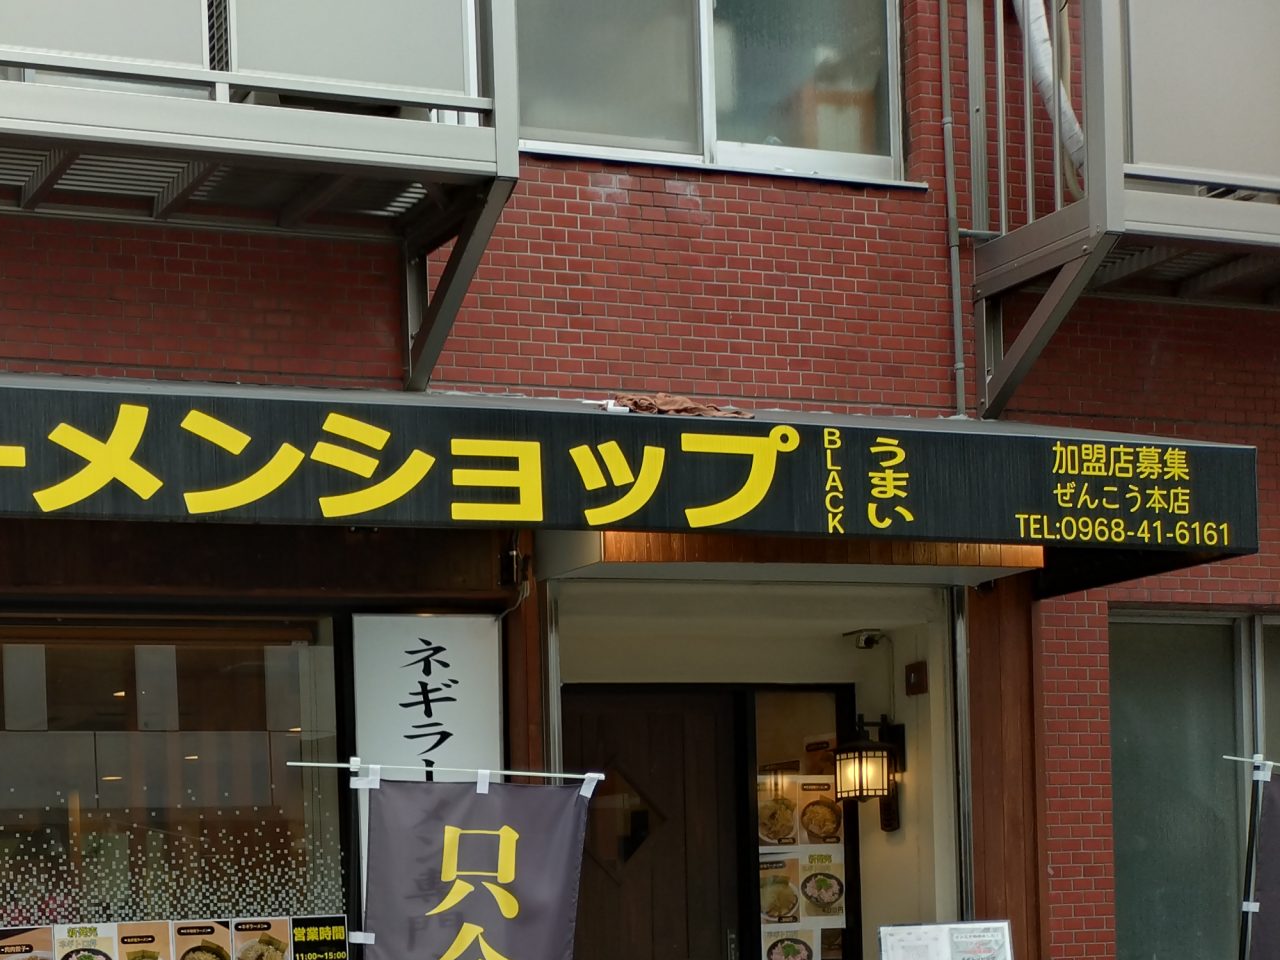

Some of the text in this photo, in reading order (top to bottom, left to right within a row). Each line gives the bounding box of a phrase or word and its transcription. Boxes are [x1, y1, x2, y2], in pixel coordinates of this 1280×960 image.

[1051, 440, 1191, 482] 加盟店募集
[823, 427, 845, 534] BLACK
[867, 436, 915, 529] うまい
[1052, 482, 1191, 515] ぜんこう本店
[1014, 513, 1231, 547] TEL:0968-41-6161
[293, 926, 346, 942] 営業時間
